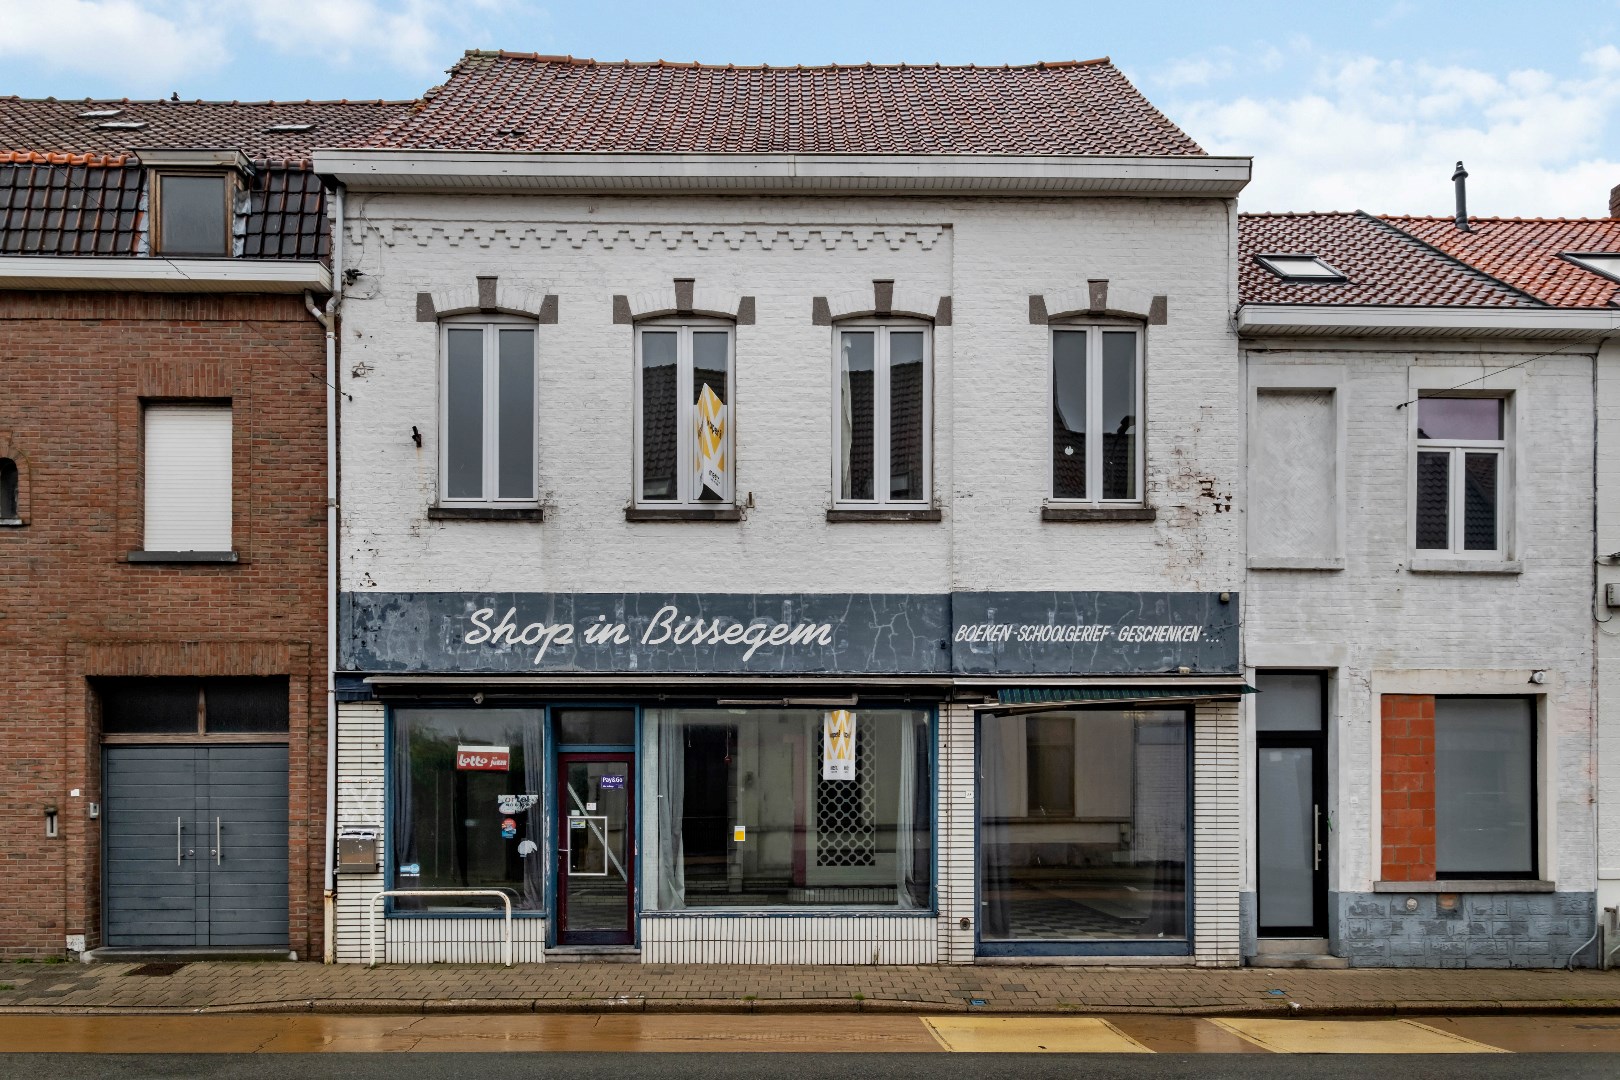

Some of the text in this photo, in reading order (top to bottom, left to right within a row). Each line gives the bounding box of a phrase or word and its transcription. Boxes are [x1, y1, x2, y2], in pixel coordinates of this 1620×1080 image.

[465, 605, 832, 664] Shop in Bissegem
